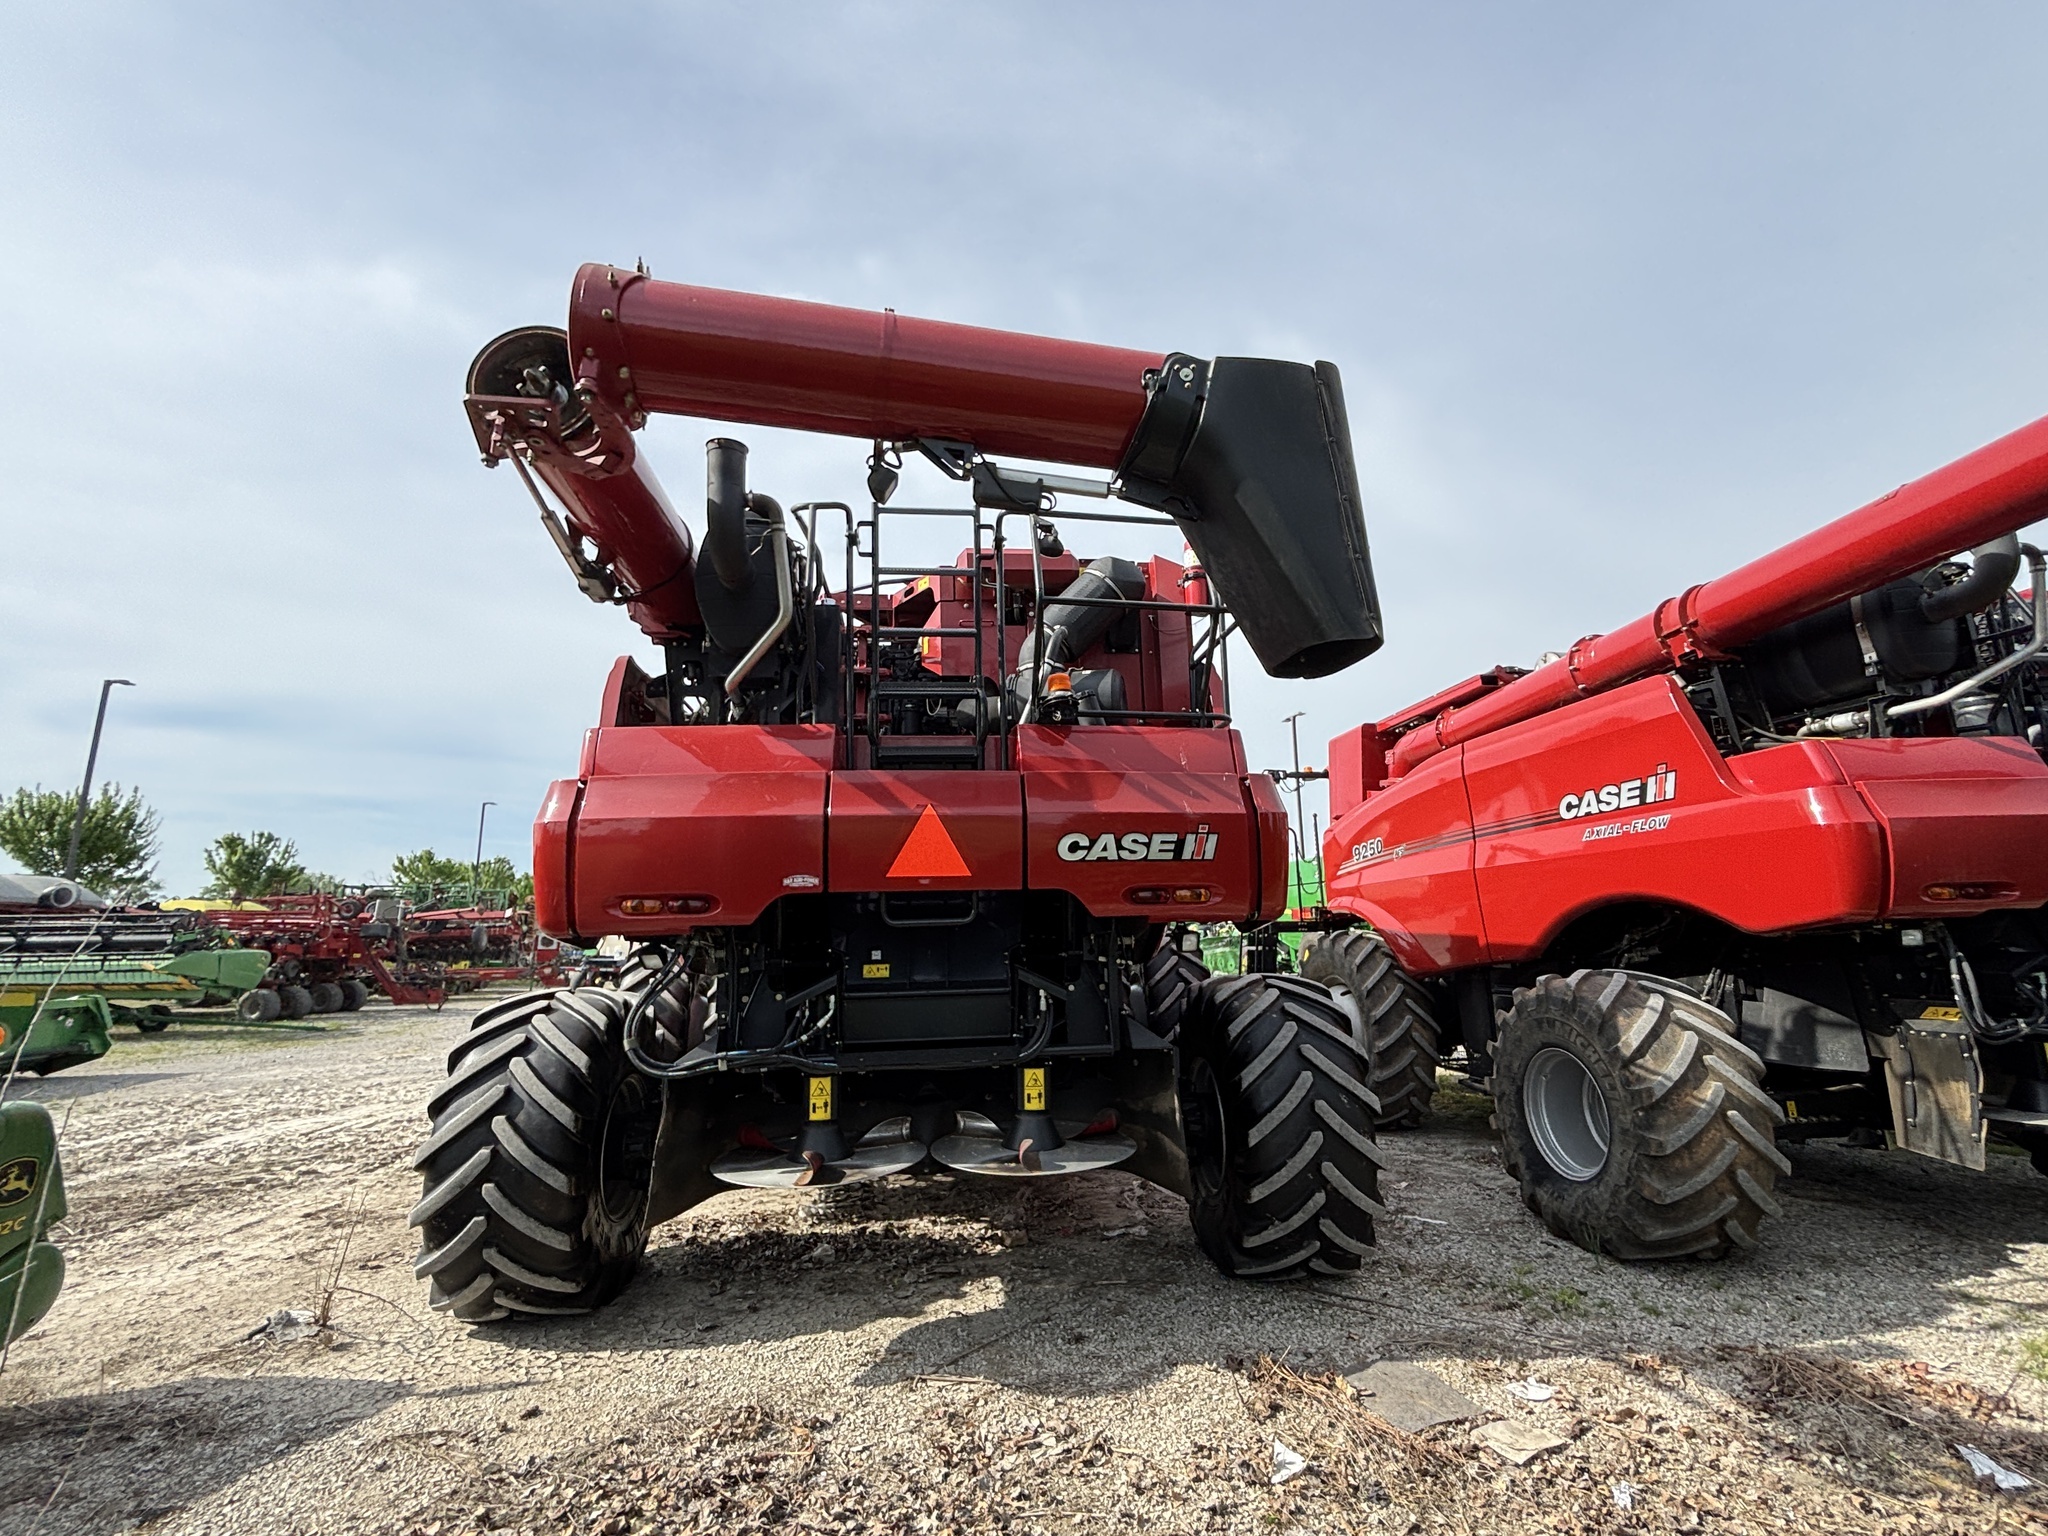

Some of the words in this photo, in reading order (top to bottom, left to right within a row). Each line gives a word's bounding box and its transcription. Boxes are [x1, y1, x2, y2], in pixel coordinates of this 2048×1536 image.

[1559, 778, 1641, 820] CASE
[1582, 815, 1671, 841] AXIAL-FLOW
[1057, 832, 1178, 861] CASE
[1352, 837, 1383, 862] 9250
